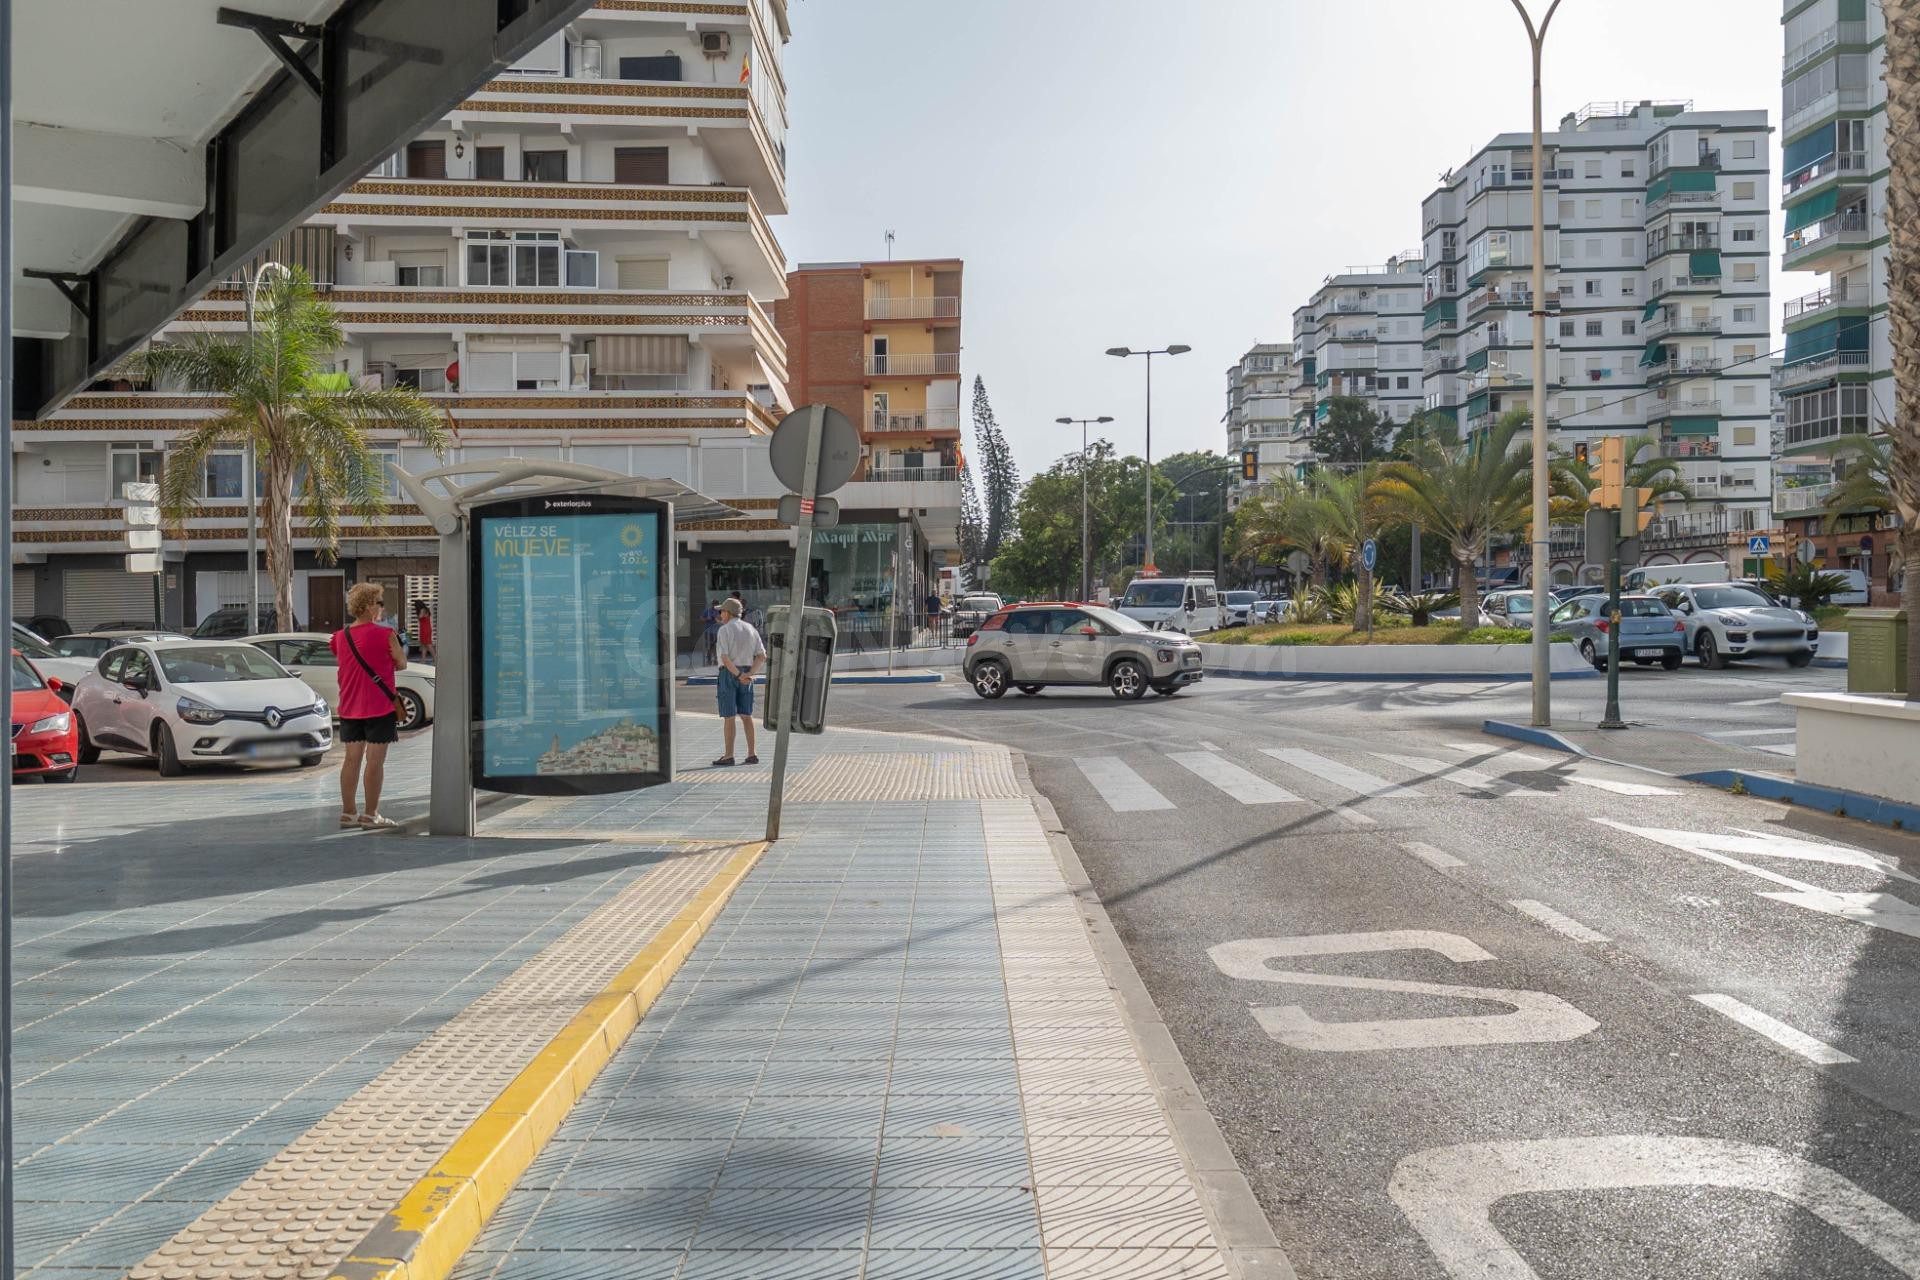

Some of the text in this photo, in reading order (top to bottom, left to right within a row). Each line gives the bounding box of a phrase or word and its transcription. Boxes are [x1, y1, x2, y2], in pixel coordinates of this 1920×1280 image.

[552, 500, 592, 508] exteriorplus
[494, 523, 557, 538] VÉLEZ SE
[862, 530, 894, 543] Mar
[494, 538, 572, 558] MUEVE
